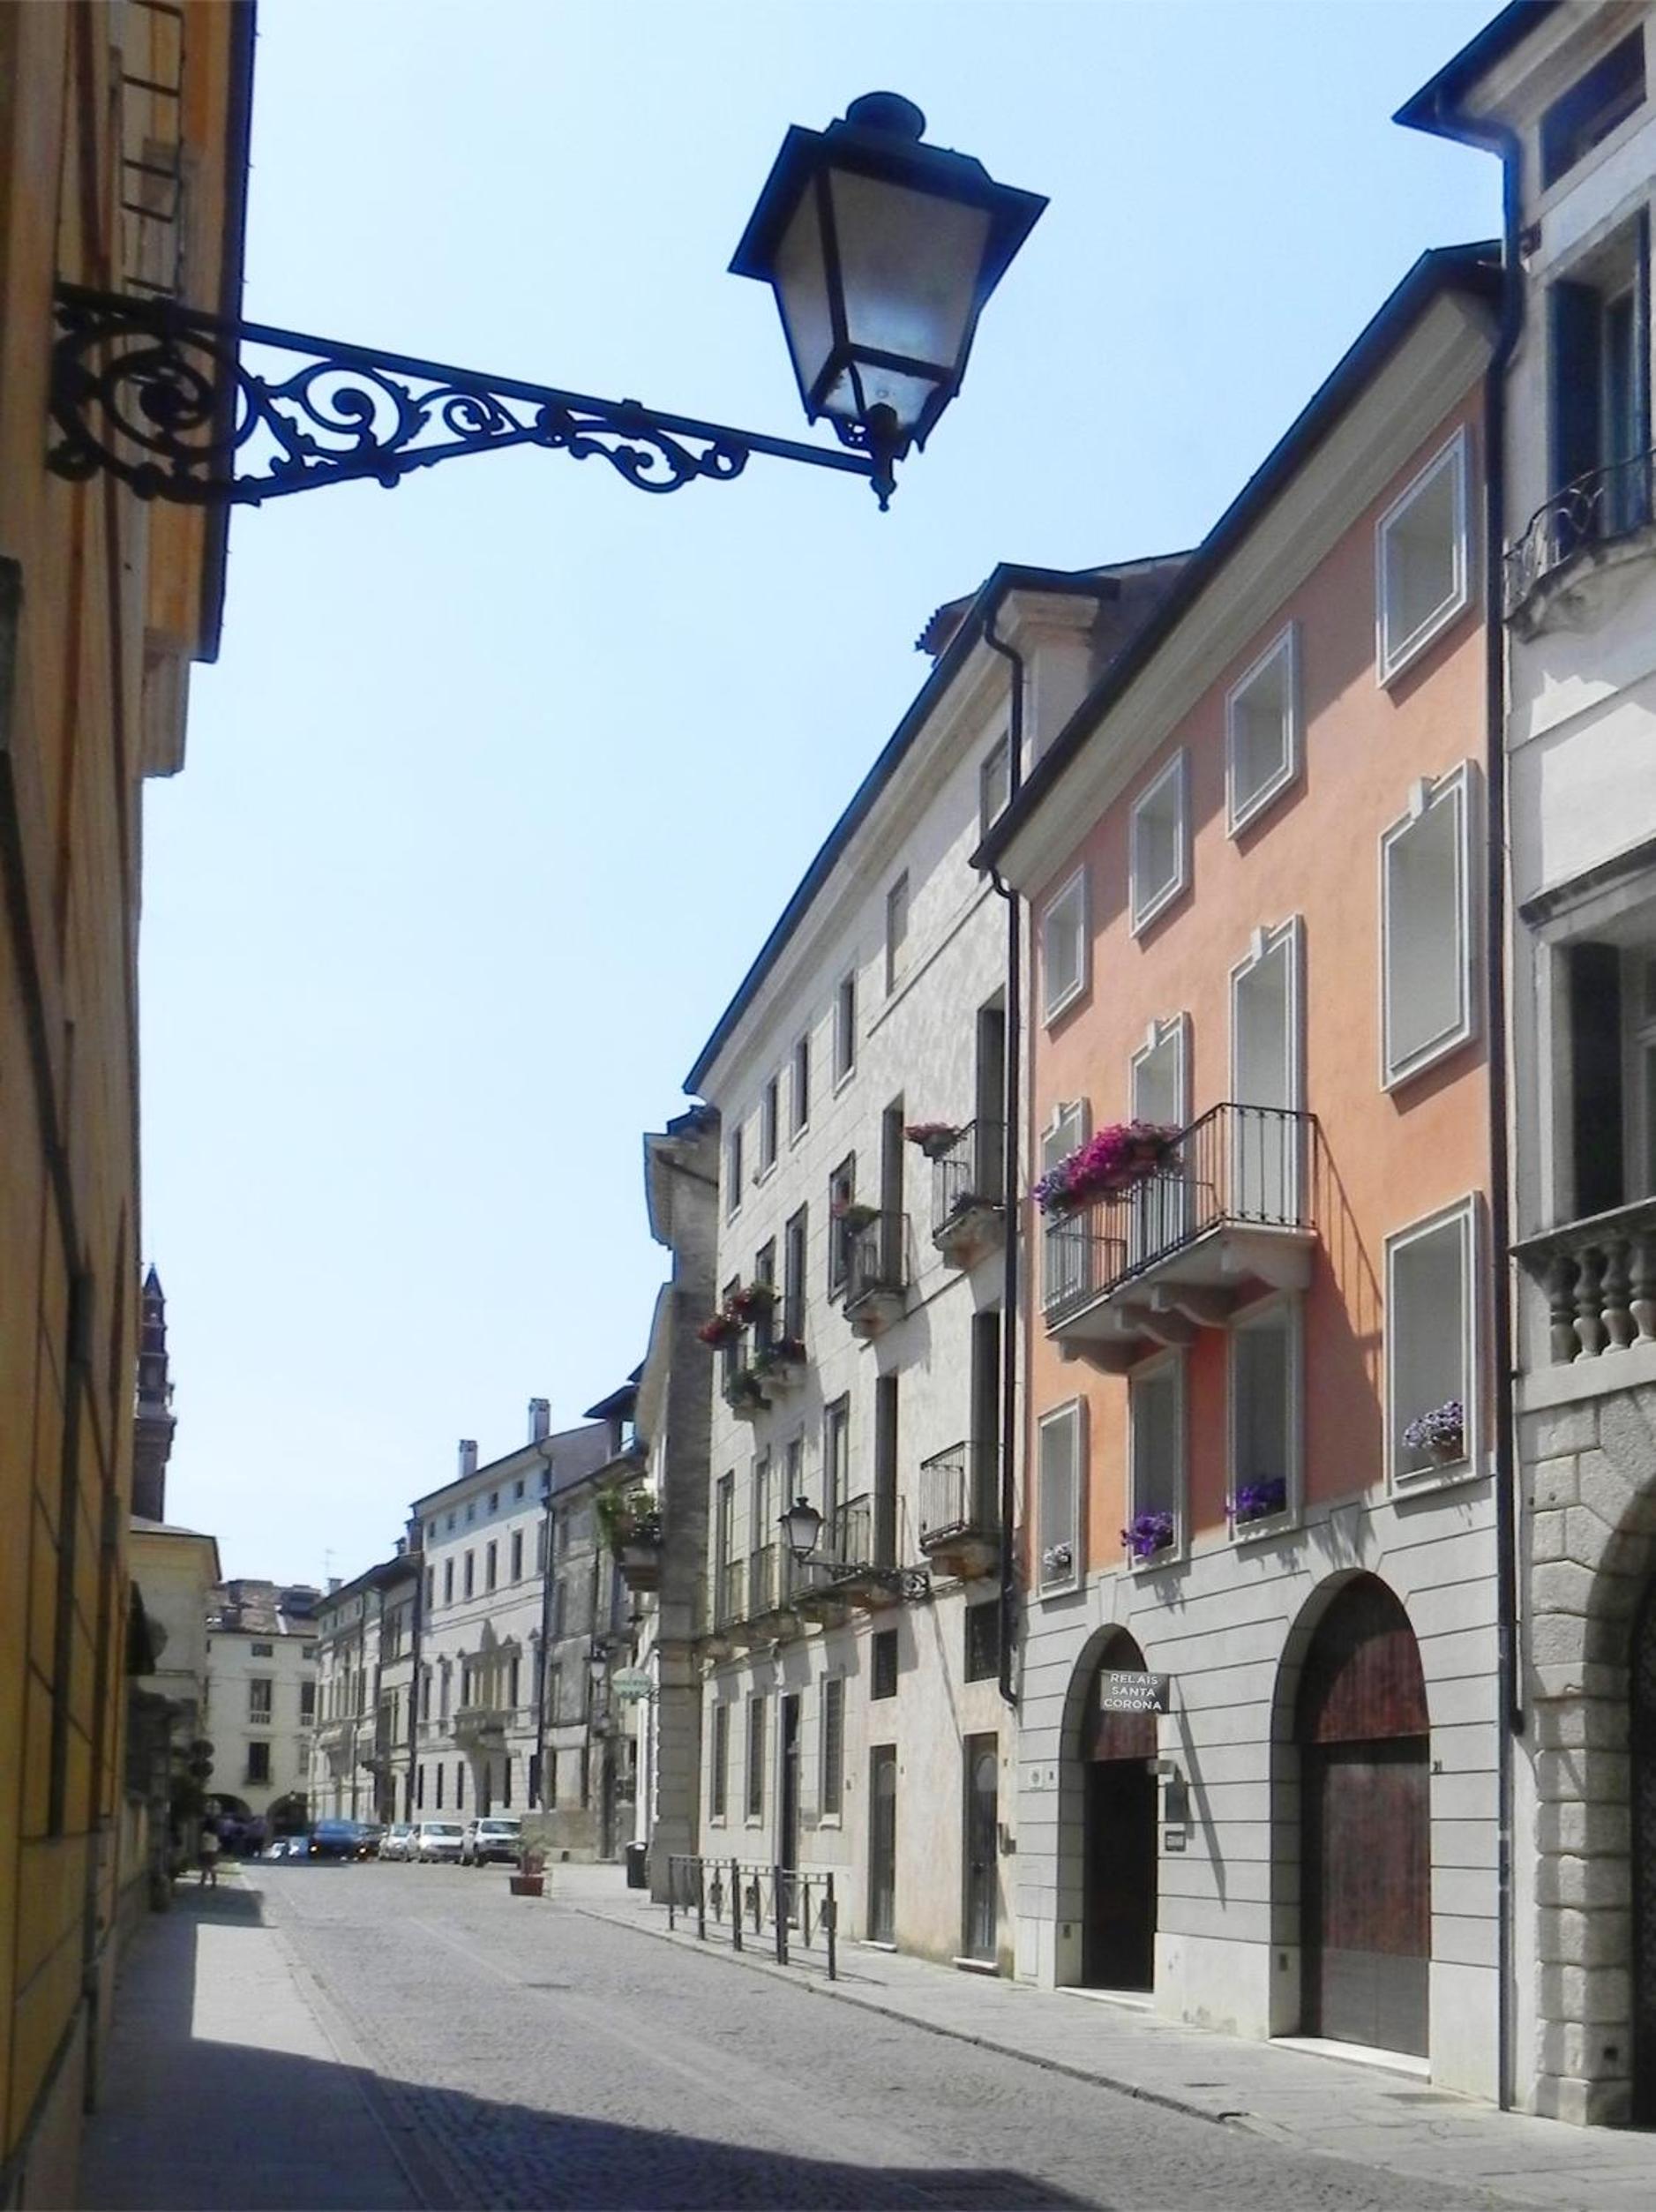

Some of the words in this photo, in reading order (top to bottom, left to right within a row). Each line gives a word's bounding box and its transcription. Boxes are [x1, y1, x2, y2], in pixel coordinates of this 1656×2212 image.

[1110, 1673, 1158, 1684] RELAIS
[1112, 1686, 1156, 1697] SANTA
[1104, 1698, 1162, 1710] CORONA
